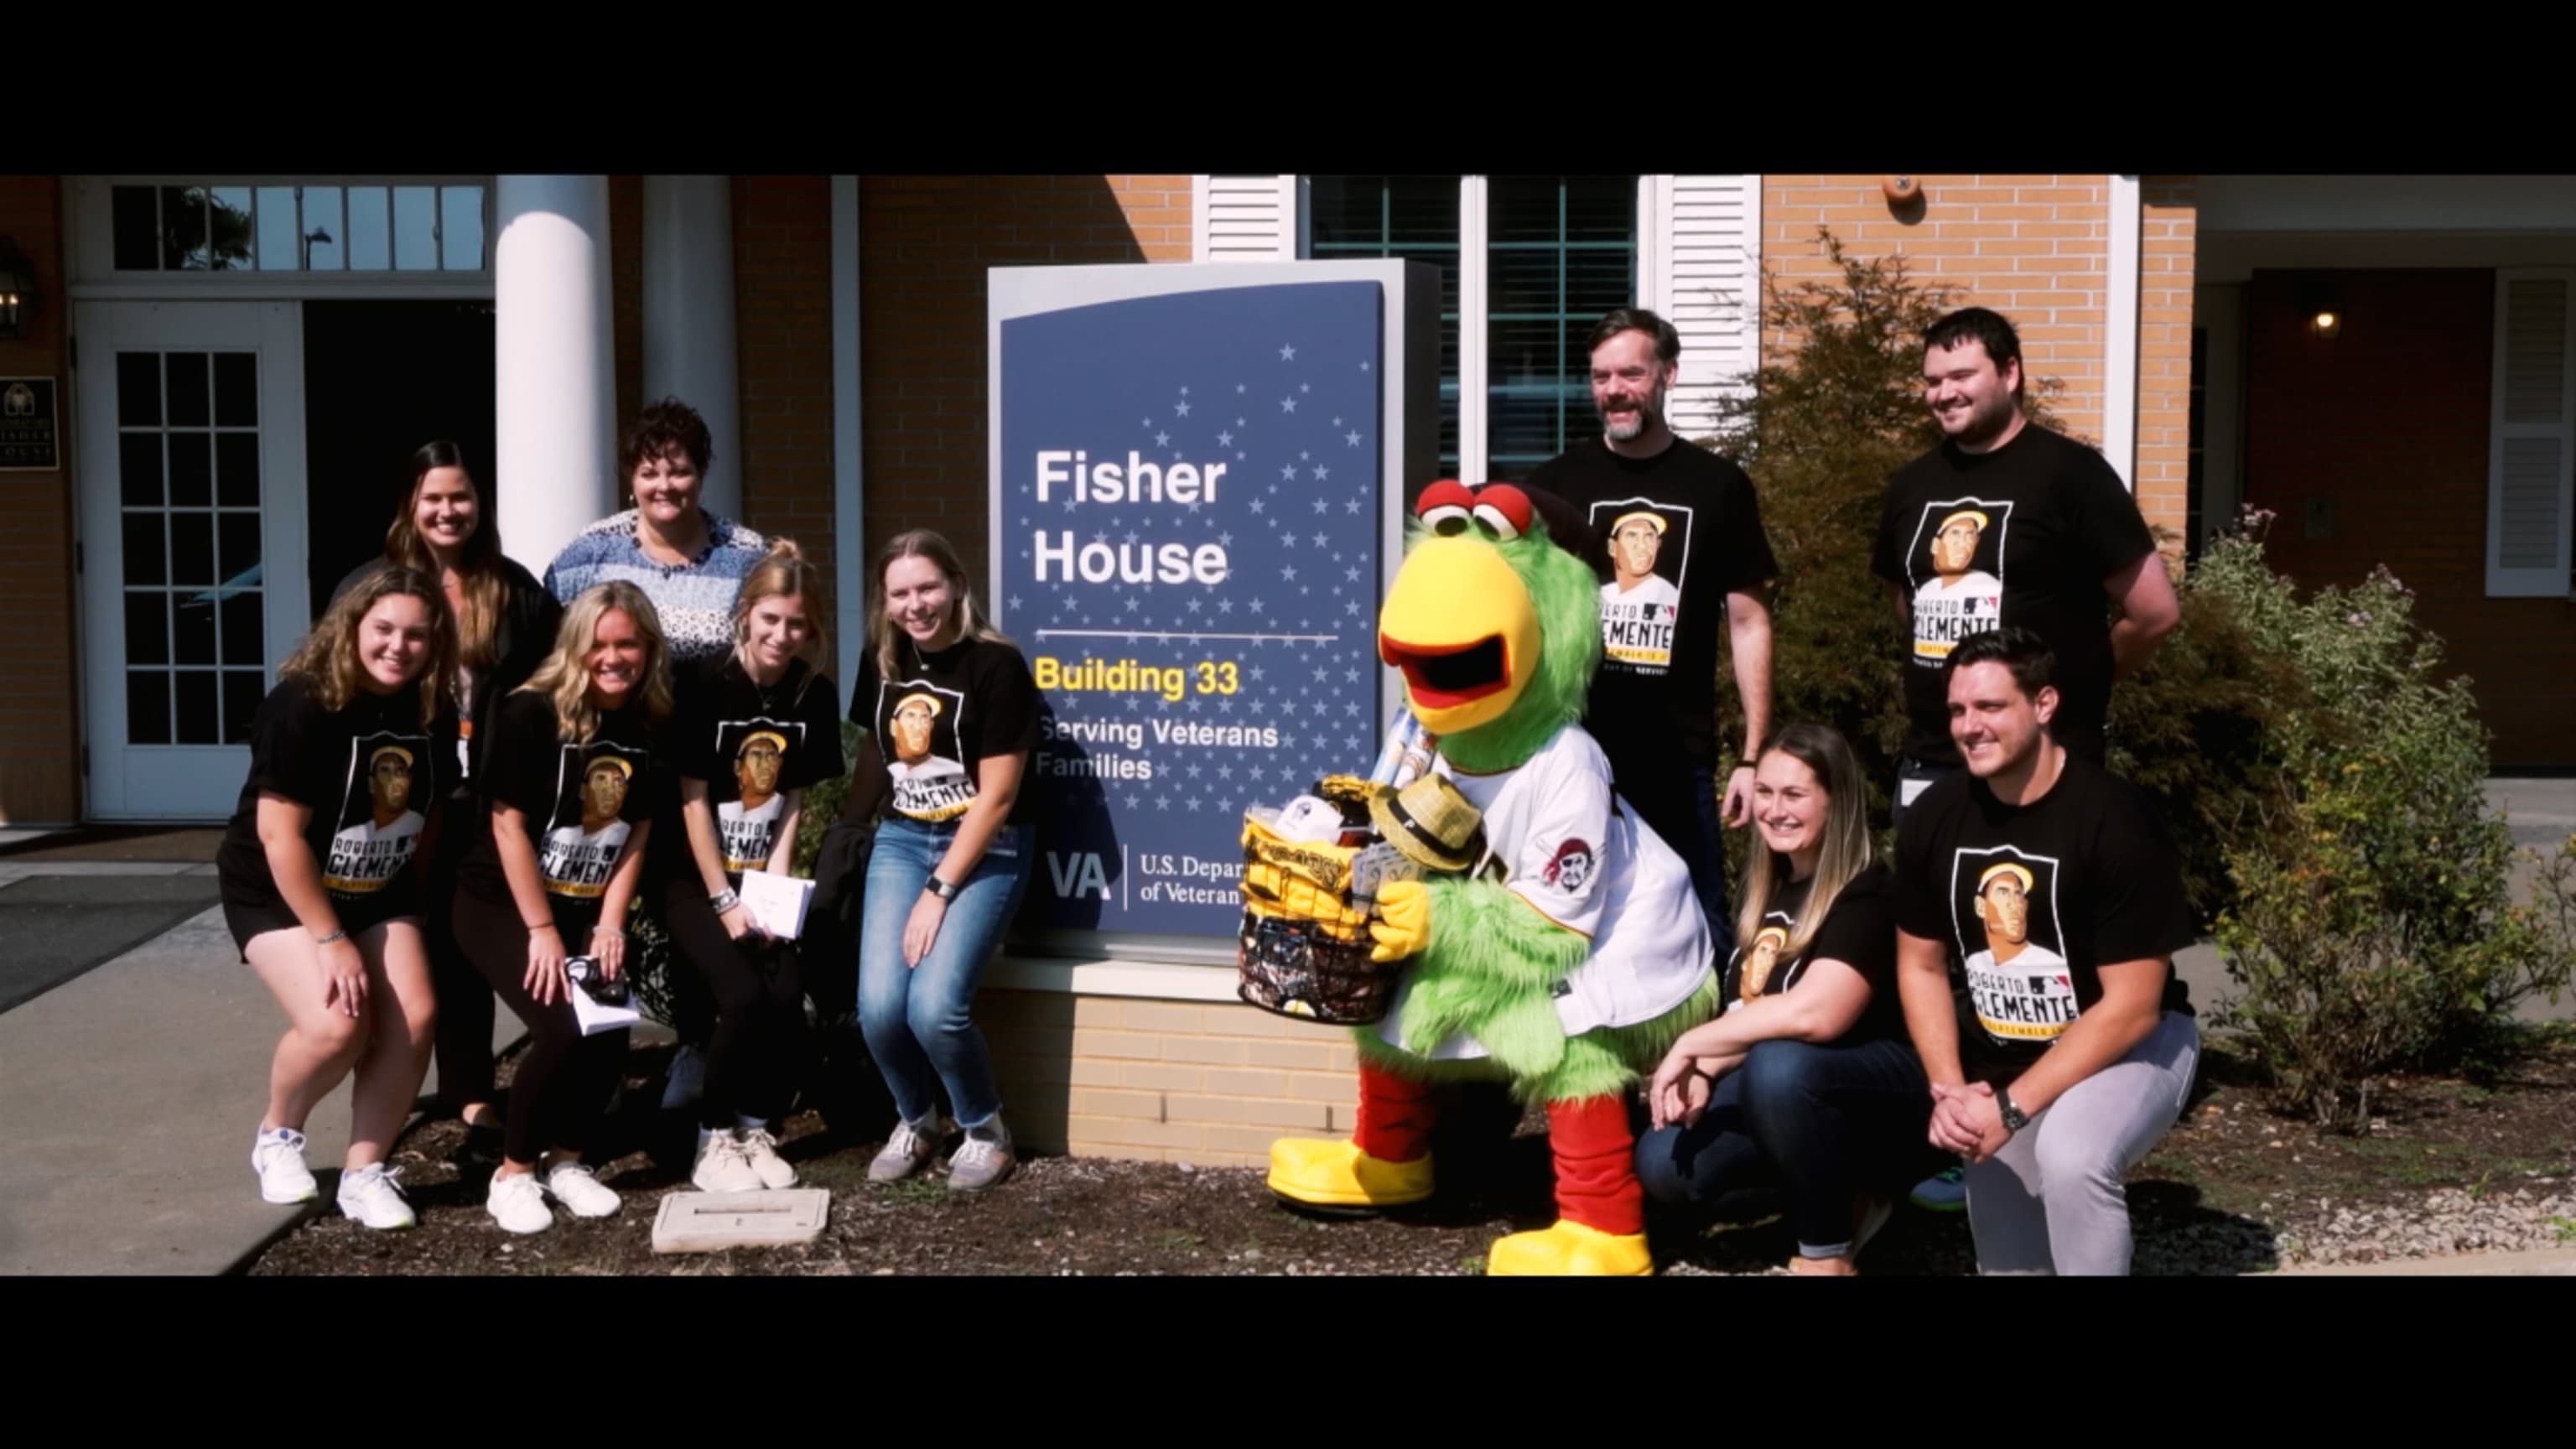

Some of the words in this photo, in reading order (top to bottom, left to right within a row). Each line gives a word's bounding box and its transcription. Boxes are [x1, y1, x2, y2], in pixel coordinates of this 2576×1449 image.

[1036, 449, 1227, 503] Fisher
[1034, 529, 1228, 584] House
[1034, 657, 1185, 702] Building
[1196, 662, 1239, 695] 33
[1040, 715, 1143, 750] Serving
[1152, 719, 1279, 748] Veterans
[1036, 754, 1152, 781] Families
[1046, 851, 1112, 901] VA
[1140, 854, 1177, 875] U.S.
[1182, 855, 1244, 883] Depar
[1140, 883, 1159, 902] of
[1165, 883, 1241, 905] Veteran
